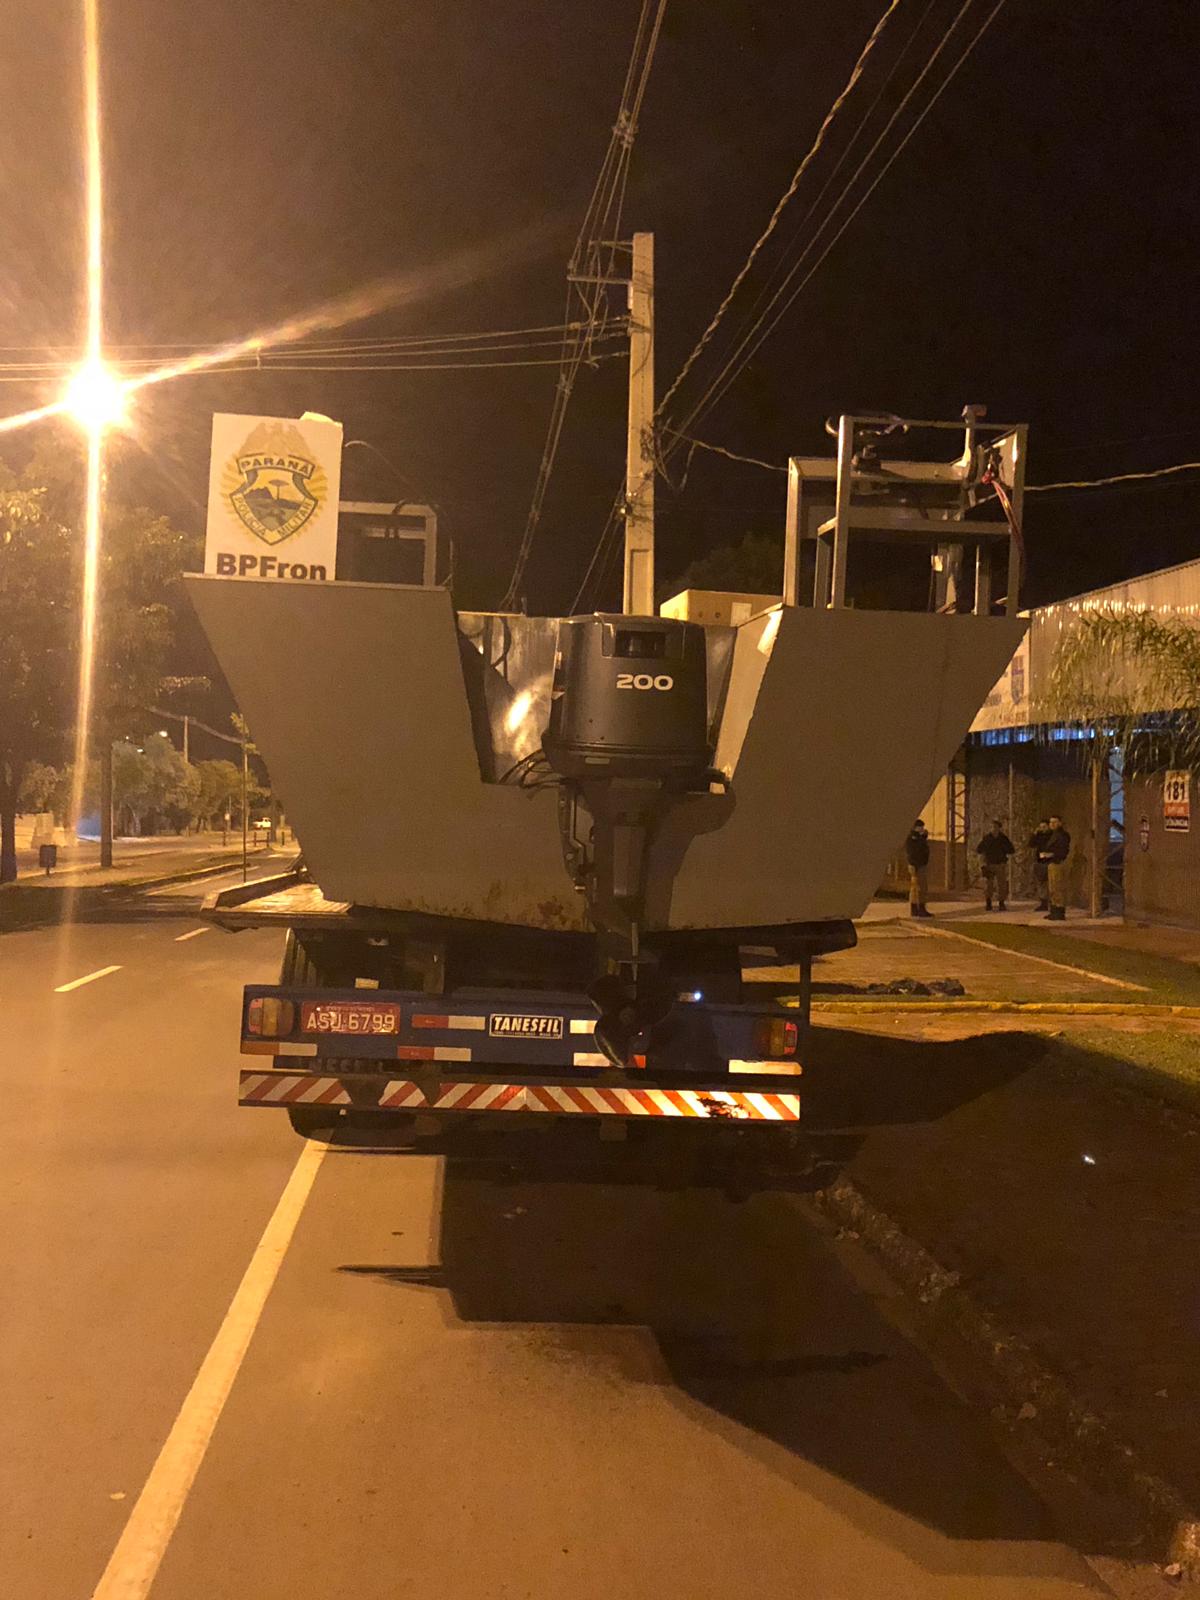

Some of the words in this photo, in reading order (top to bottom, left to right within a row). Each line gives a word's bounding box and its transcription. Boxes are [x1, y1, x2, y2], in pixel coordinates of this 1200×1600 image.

[216, 553, 326, 580] BPFron
[616, 674, 673, 691] 200
[494, 1016, 560, 1033] TANESFIL
